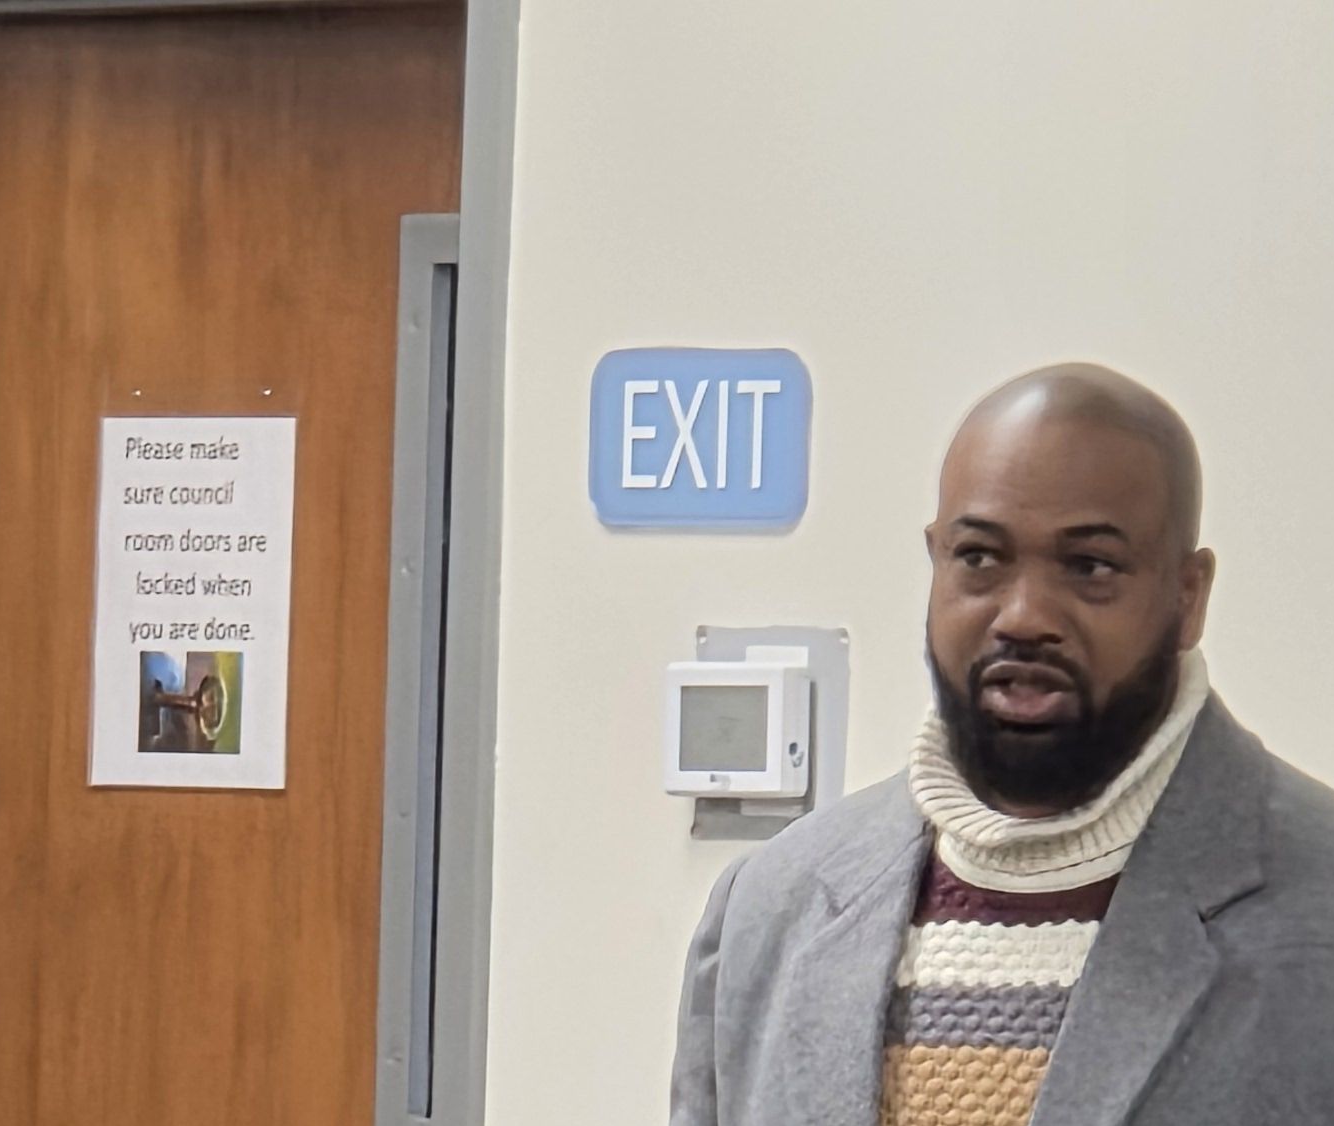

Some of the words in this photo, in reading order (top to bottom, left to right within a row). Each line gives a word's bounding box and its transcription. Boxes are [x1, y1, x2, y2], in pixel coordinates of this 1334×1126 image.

[621, 379, 781, 489] EXIT
[125, 436, 184, 461] Please
[189, 435, 240, 461] make
[123, 485, 164, 505] sure
[169, 480, 235, 505] council
[124, 533, 175, 552] room
[179, 528, 232, 553] doors
[237, 534, 267, 553] are
[136, 570, 197, 596] locked
[201, 572, 252, 597] when
[128, 621, 164, 645] you
[168, 622, 200, 641] are
[203, 616, 255, 642] done.
